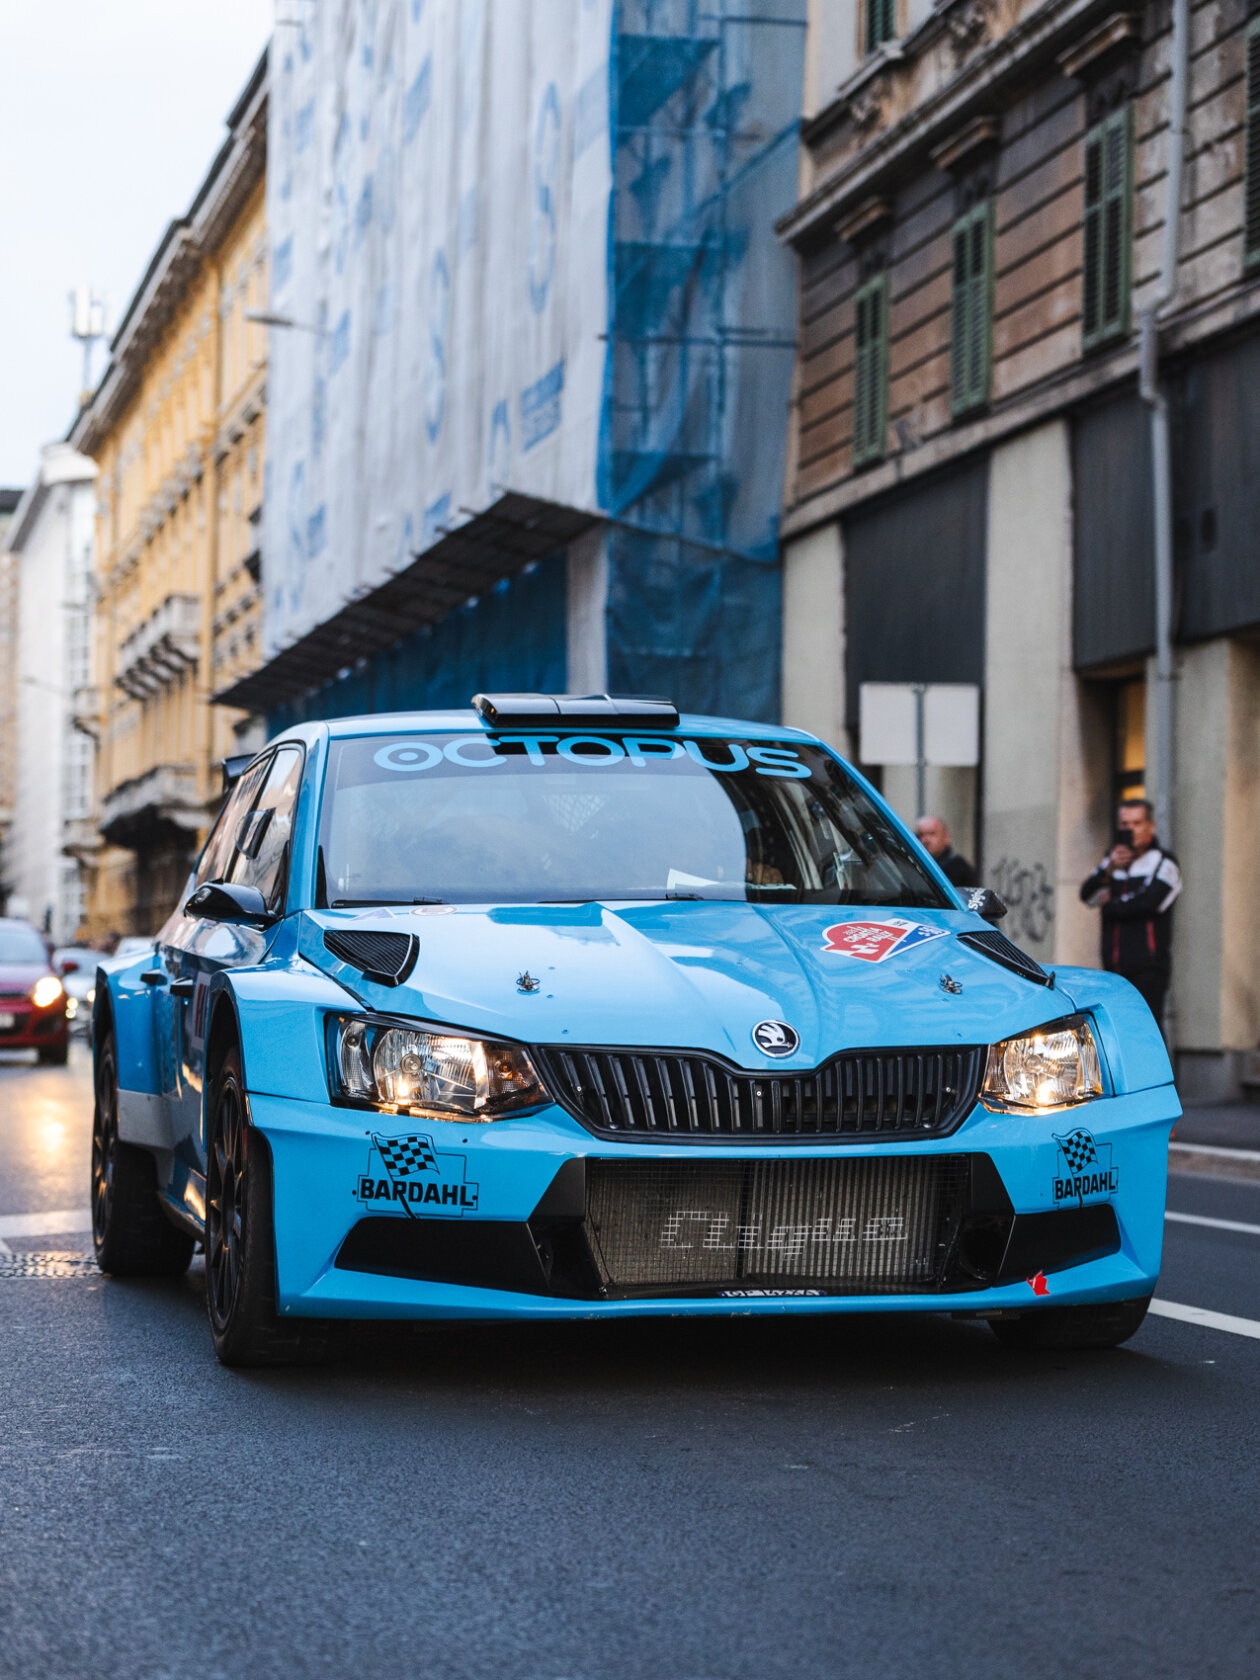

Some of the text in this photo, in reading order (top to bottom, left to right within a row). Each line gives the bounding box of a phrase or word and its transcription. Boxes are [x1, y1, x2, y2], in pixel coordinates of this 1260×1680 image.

[374, 735, 813, 778] OCTOPUS
[361, 1179, 474, 1206] BARDAHL
[1055, 1171, 1116, 1200] BARDAHL
